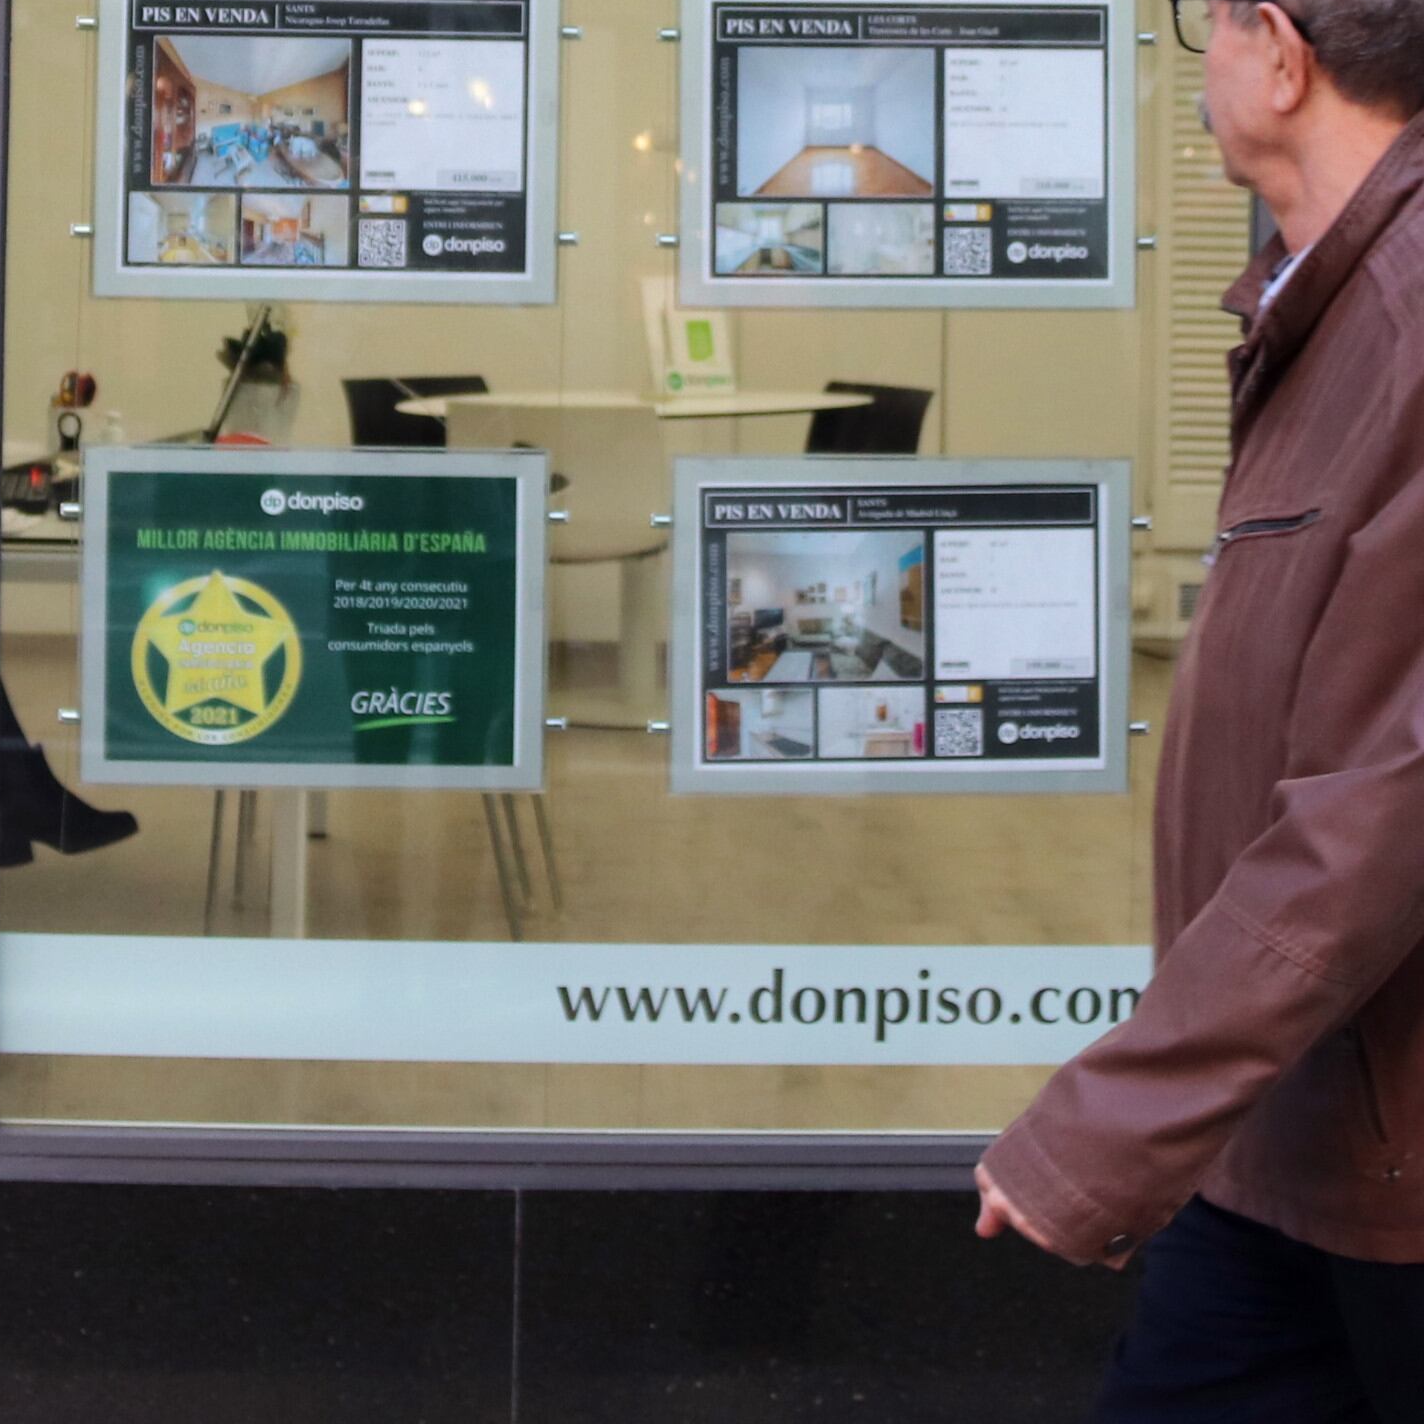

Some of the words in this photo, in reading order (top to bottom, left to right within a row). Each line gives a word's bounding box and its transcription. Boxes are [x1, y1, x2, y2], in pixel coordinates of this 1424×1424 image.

[142, 6, 170, 22] PIS
[175, 7, 200, 23] EN
[205, 8, 269, 24] VENDA
[726, 19, 755, 34] PIS
[759, 19, 784, 34] EN
[789, 19, 853, 35] VENDA
[131, 45, 144, 174] www.donpiso.com
[444, 235, 505, 256] donpiso
[1028, 243, 1088, 264] donpiso
[287, 490, 365, 514] donpiso
[715, 504, 743, 519] PIS
[747, 504, 773, 519] EN
[778, 504, 841, 520] VENDA
[137, 529, 199, 549] MILLOR
[203, 525, 275, 550] AGÈNCIA
[280, 528, 399, 552] IMMOBILIÀRIA
[404, 529, 487, 553] D'ESPAÑA
[335, 579, 357, 592] Per
[359, 580, 373, 593] 4t
[375, 582, 398, 596] any
[400, 580, 468, 593] consecutiu
[333, 595, 468, 610] 2018/2019/2020/2021
[367, 622, 405, 635] Triada
[409, 623, 435, 638] pels
[179, 640, 256, 656] Agencia
[328, 639, 408, 653] consumidors
[411, 641, 474, 656] espanyols
[351, 686, 453, 715] GRÀCIES
[190, 706, 239, 725] 2021
[1020, 723, 1080, 743] donpiso
